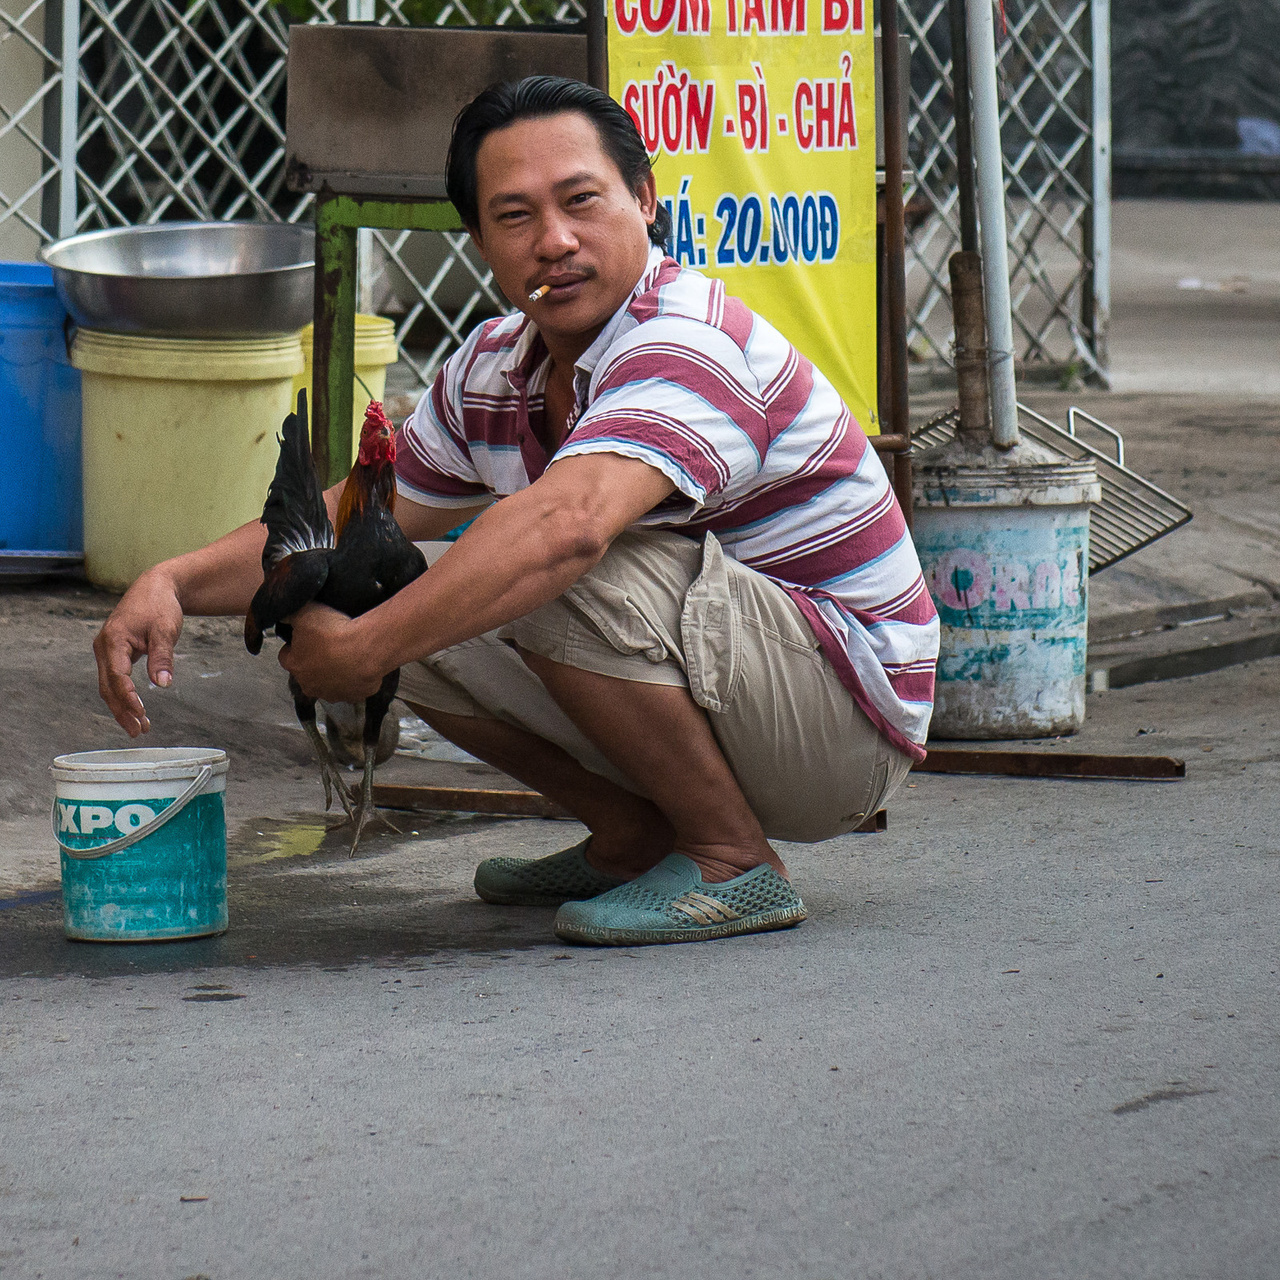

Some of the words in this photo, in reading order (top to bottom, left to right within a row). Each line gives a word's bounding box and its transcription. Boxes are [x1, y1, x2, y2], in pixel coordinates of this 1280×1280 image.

[624, 64, 715, 153] SƯỜN
[795, 54, 857, 150] CHẢ
[664, 179, 707, 266] IÁ:
